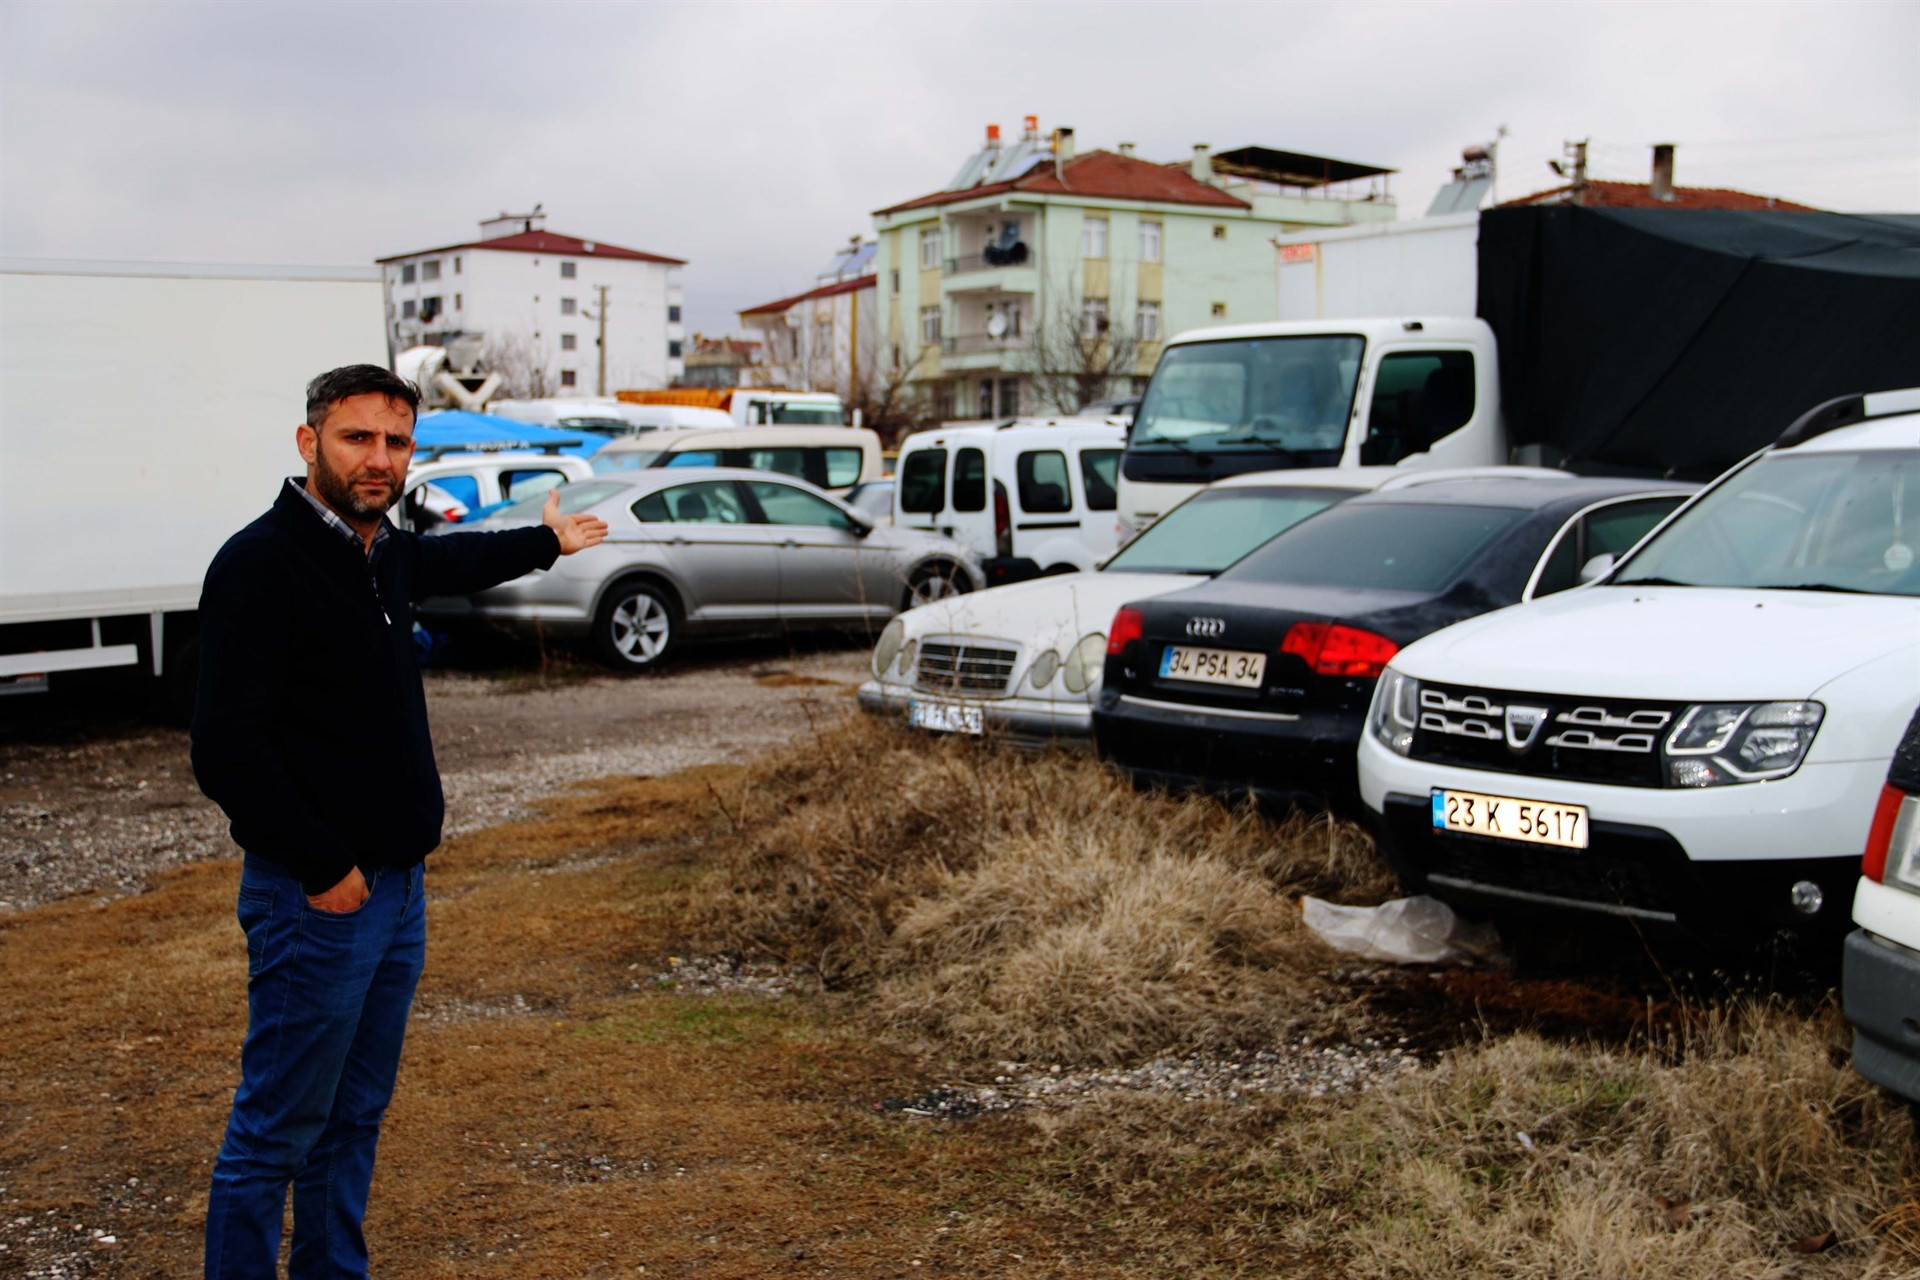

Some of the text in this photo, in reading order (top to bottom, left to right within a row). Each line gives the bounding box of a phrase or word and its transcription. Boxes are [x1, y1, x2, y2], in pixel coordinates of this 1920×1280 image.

[1170, 651, 1258, 681] 34 PSA 34
[1448, 796, 1579, 842] 23 K 5617
